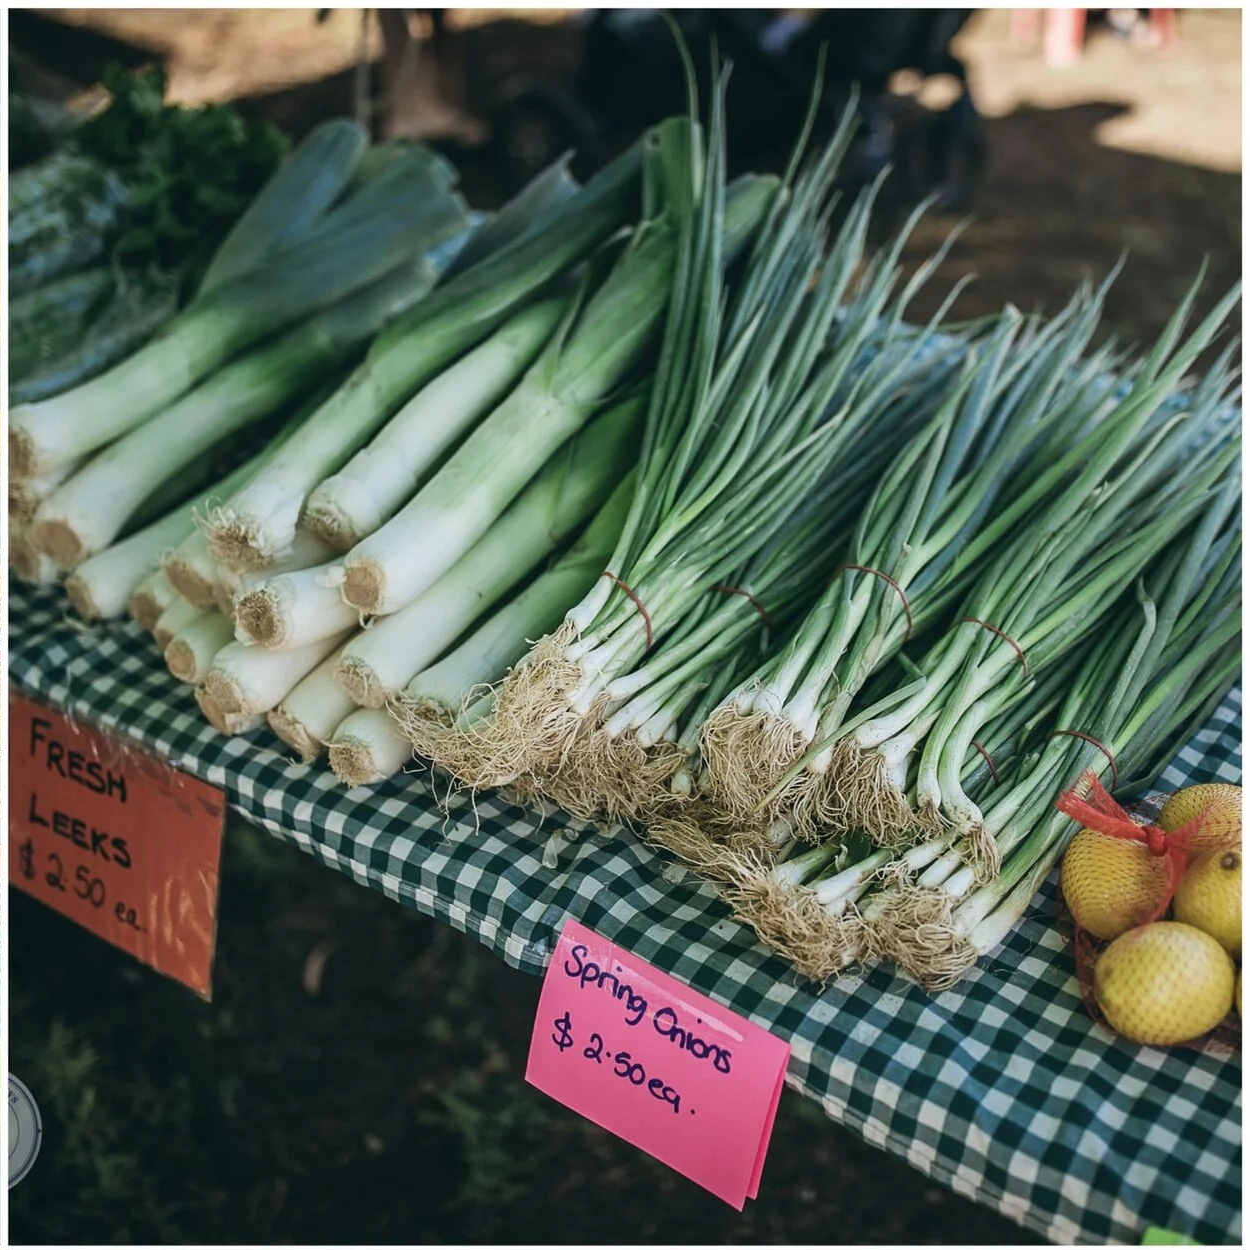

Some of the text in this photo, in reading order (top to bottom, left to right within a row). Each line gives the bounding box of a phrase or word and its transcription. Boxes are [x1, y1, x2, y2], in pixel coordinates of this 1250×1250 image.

[30, 717, 128, 804] FRESH
[28, 790, 132, 870] LEEKS
[551, 1011, 573, 1052] $
[564, 945, 732, 1074] Spring Onions
